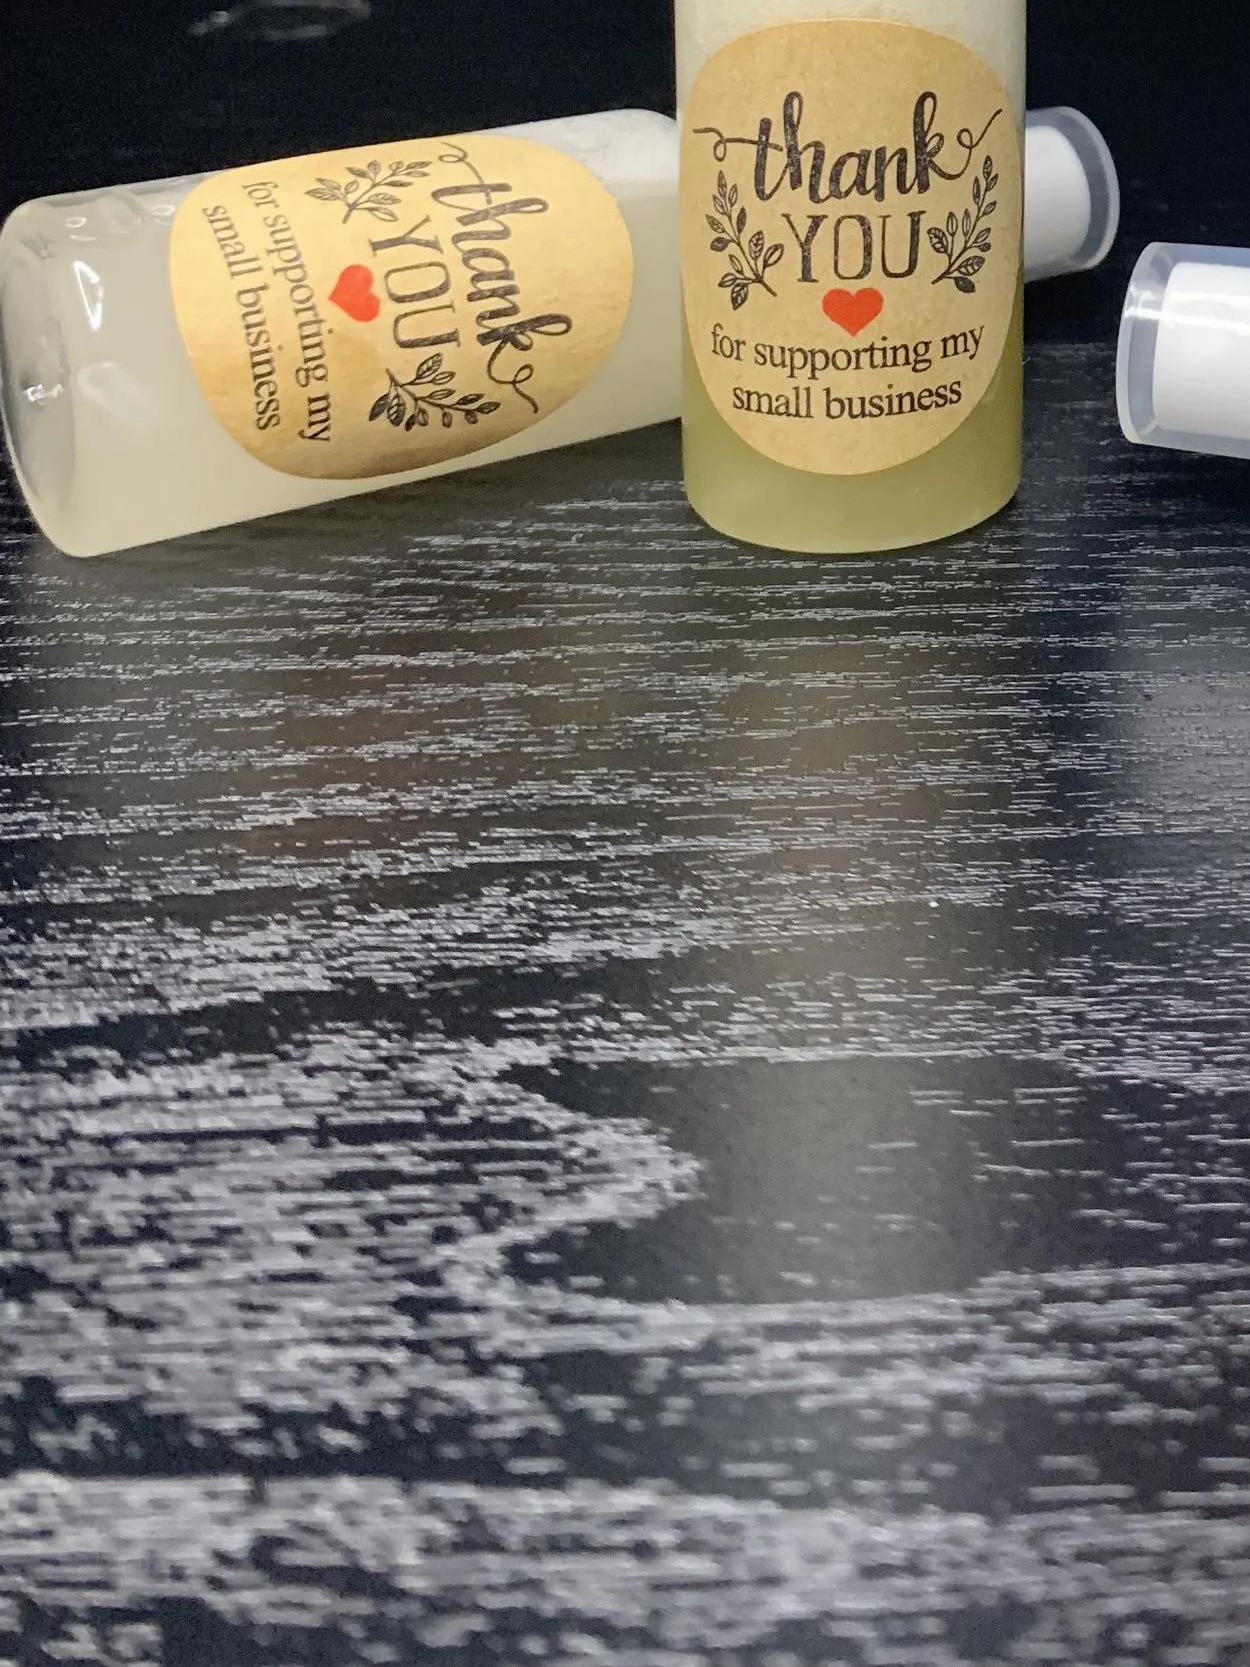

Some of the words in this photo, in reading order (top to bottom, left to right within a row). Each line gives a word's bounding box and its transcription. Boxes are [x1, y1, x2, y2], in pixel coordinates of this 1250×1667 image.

[693, 91, 1004, 203] thank
[241, 180, 280, 209] for
[367, 215, 461, 351] YOU
[432, 141, 573, 414] thank
[781, 210, 926, 283] YOU
[201, 204, 265, 280] small
[236, 282, 284, 432] business
[262, 213, 334, 388] supporting
[710, 323, 746, 361] for
[754, 335, 932, 381] supporting
[941, 325, 985, 361] my
[297, 393, 332, 443] my
[732, 386, 814, 418] small
[823, 380, 962, 420] business
